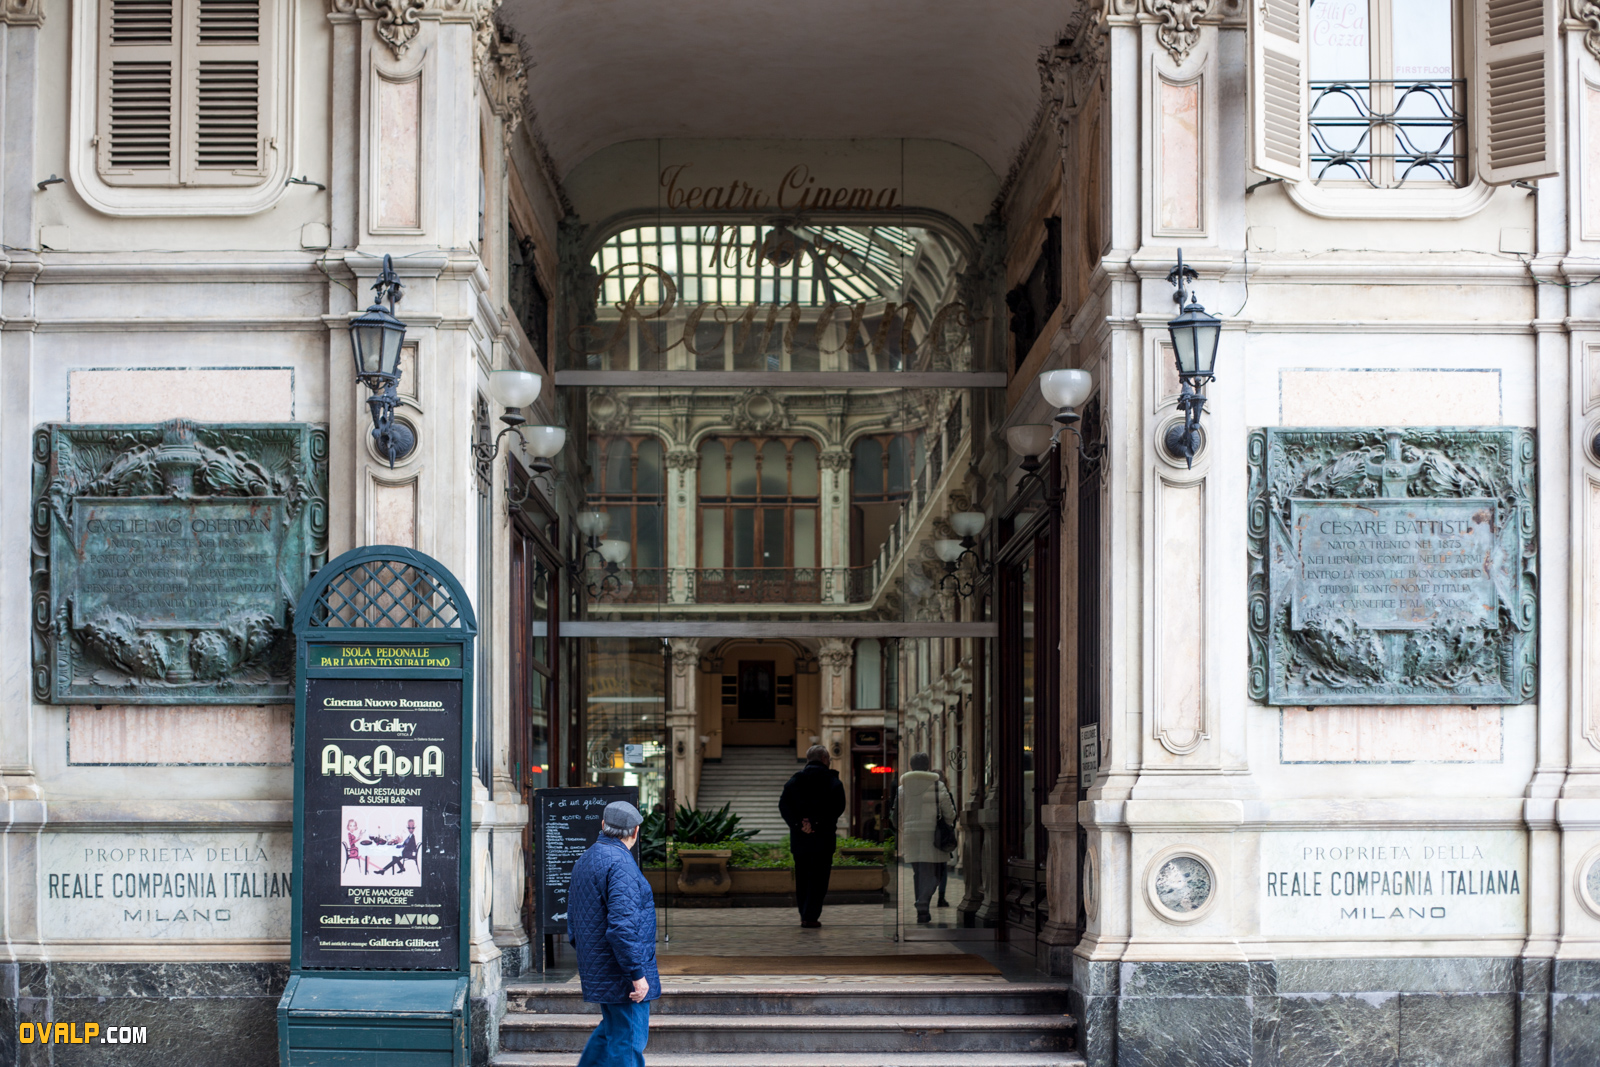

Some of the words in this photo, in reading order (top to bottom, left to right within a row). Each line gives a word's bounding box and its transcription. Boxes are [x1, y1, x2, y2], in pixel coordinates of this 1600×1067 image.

[1313, 20, 1364, 47] Cozza
[1396, 66, 1422, 74] FIRST
[1423, 66, 1451, 74] FLOOR
[660, 162, 769, 210] Teatro
[777, 163, 902, 210] Cinema
[703, 221, 856, 269] Nuovo
[568, 262, 989, 355] Romano
[192, 519, 271, 535] OBERDAN
[1319, 520, 1387, 536] CESARE
[1395, 520, 1470, 534] BATTISTI
[111, 539, 140, 548] NATO
[144, 539, 151, 548] A
[154, 539, 195, 548] TRIESTE
[1328, 540, 1355, 550] NATO
[1359, 540, 1367, 550] A
[1370, 540, 1410, 550] TRENTO
[1415, 540, 1432, 550] NEL
[1438, 540, 1462, 550] 1875
[228, 554, 266, 564] TRIESTE
[1307, 555, 1324, 564] NEI
[1328, 555, 1353, 564] LIBRI
[1357, 555, 1373, 564] NEI
[1377, 555, 1415, 564] COMIZII
[1419, 555, 1451, 564] NELLE
[1456, 555, 1482, 564] ARMI
[98, 568, 129, 578] DALLA
[1307, 570, 1340, 579] ENTRO
[1343, 570, 1355, 579] LA
[1358, 570, 1386, 579] FOSSA
[1391, 570, 1405, 579] DEL
[1364, 585, 1398, 594] SANTO
[1400, 585, 1430, 594] NOME
[1341, 600, 1396, 609] CARNEFICE
[1400, 600, 1406, 609] E
[1409, 600, 1421, 609] AL
[1425, 600, 1464, 609] MONDO
[342, 648, 372, 657] ISOLA
[377, 648, 430, 657] PEDONALE
[323, 698, 363, 708] Cinema
[365, 698, 398, 708] Nuovo
[399, 698, 443, 708] Romano
[344, 788, 372, 796] ITALIAN
[373, 788, 422, 796] RESTAURANT
[359, 796, 366, 804] &
[367, 796, 389, 804] SUSHI
[390, 796, 406, 804] BAR
[207, 848, 269, 862] DELLA
[1424, 847, 1484, 860] DELLA
[49, 873, 104, 898] REALE
[112, 873, 217, 898] COMPAGNIA
[1267, 872, 1322, 897] REALE
[1331, 871, 1433, 896] COMPAGNIA
[1442, 870, 1521, 895] ITALIANA
[348, 889, 371, 897] DOVE
[372, 889, 414, 897] MANGIARE
[124, 910, 231, 922] MILANO
[1341, 907, 1446, 920] MILANO
[320, 914, 360, 925] Galleria
[361, 914, 392, 925] d'Arte
[395, 914, 439, 925] DAVICO
[369, 938, 404, 947] Galleria
[405, 938, 439, 947] Gilibert
